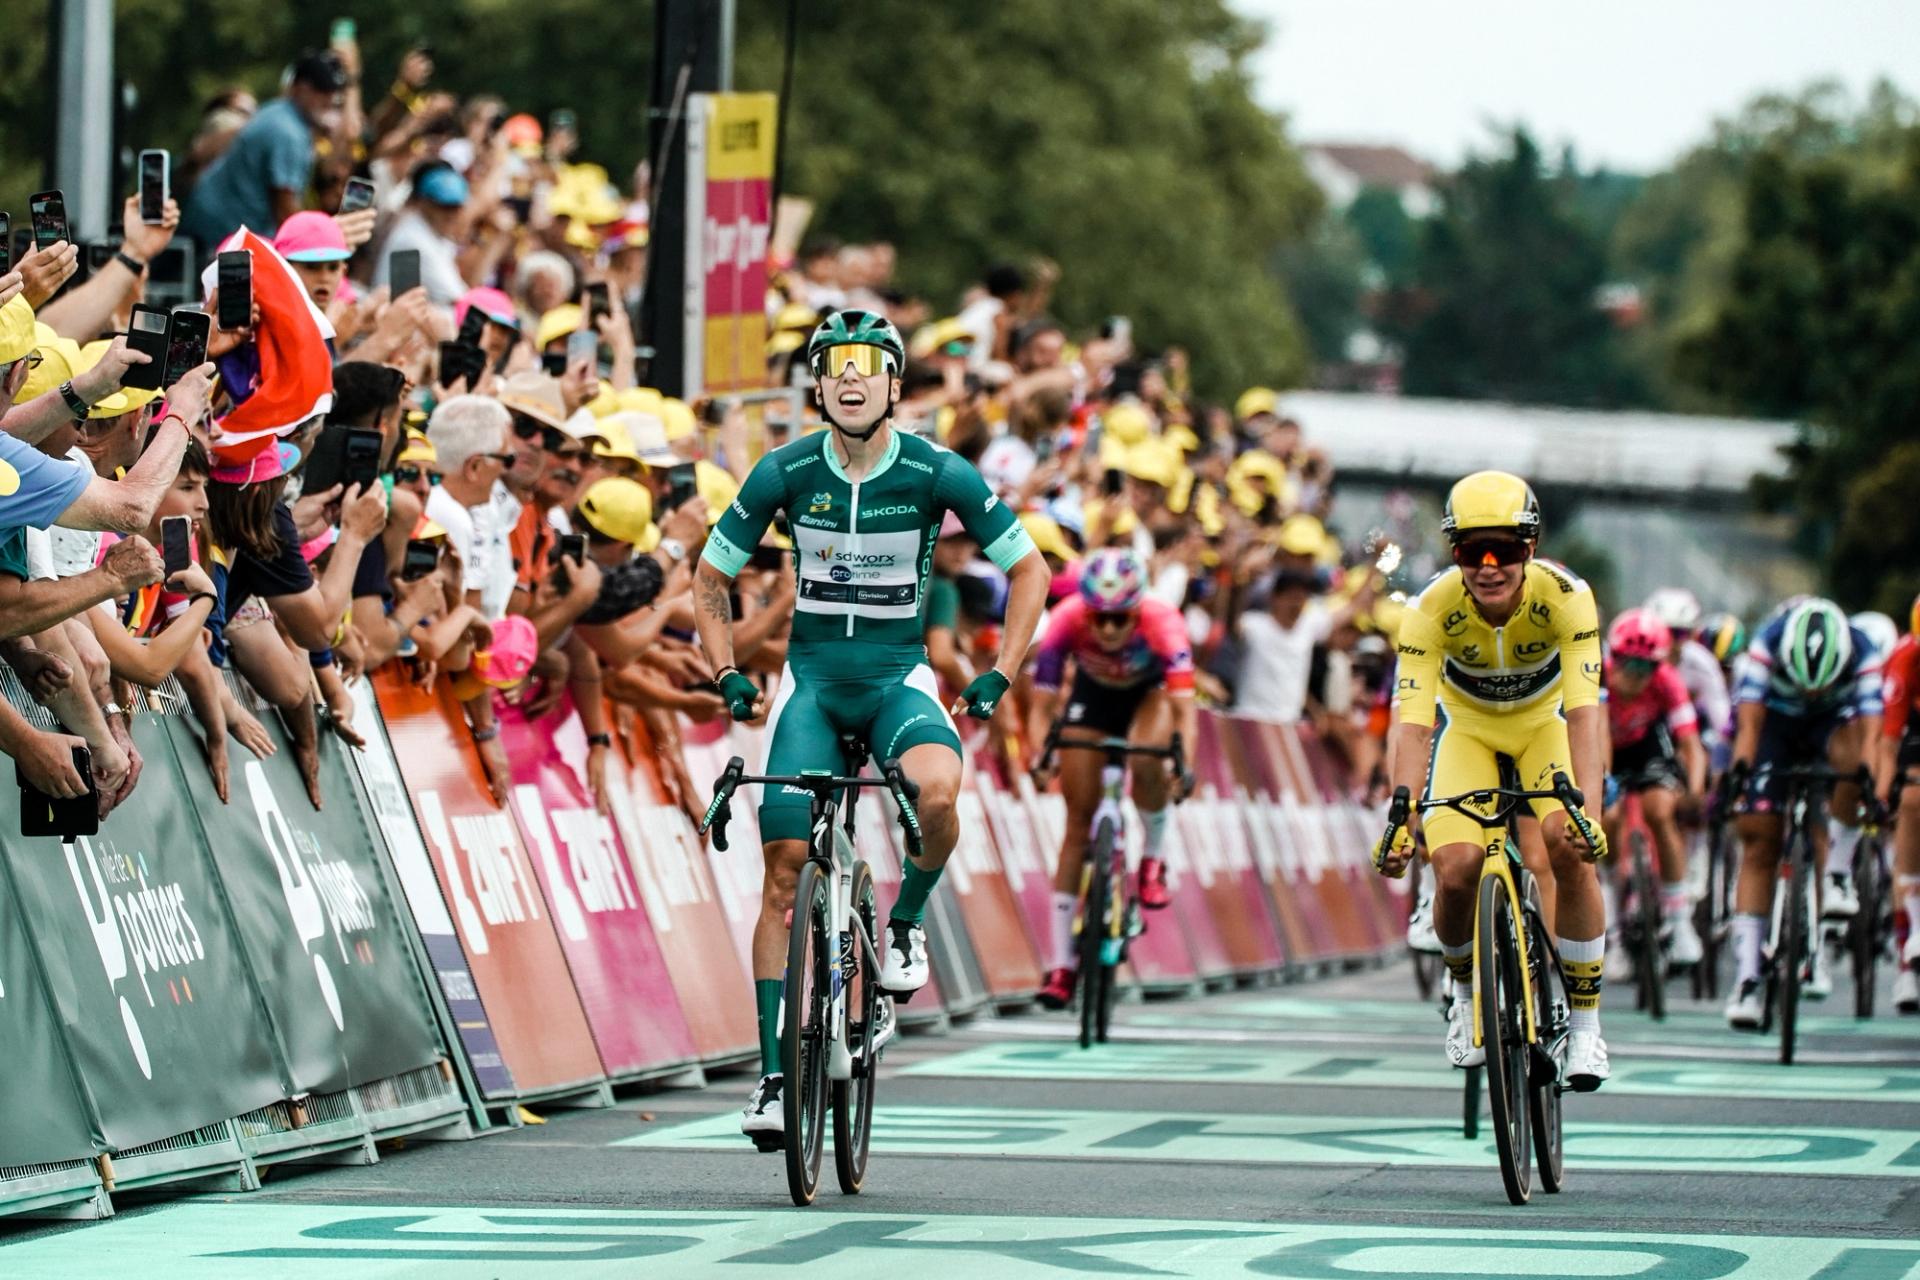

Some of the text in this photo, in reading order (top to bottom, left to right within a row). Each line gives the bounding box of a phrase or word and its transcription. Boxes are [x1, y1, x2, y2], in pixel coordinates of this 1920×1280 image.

[785, 454, 820, 473] SKODA
[900, 457, 934, 475] SKODA
[798, 514, 838, 529] Santini
[861, 505, 919, 519] SKODA
[703, 790, 726, 827] SRAM
[113, 864, 205, 1008] poitiers
[676, 1110, 1920, 1167] SKO
[190, 1214, 1920, 1280] SKO
